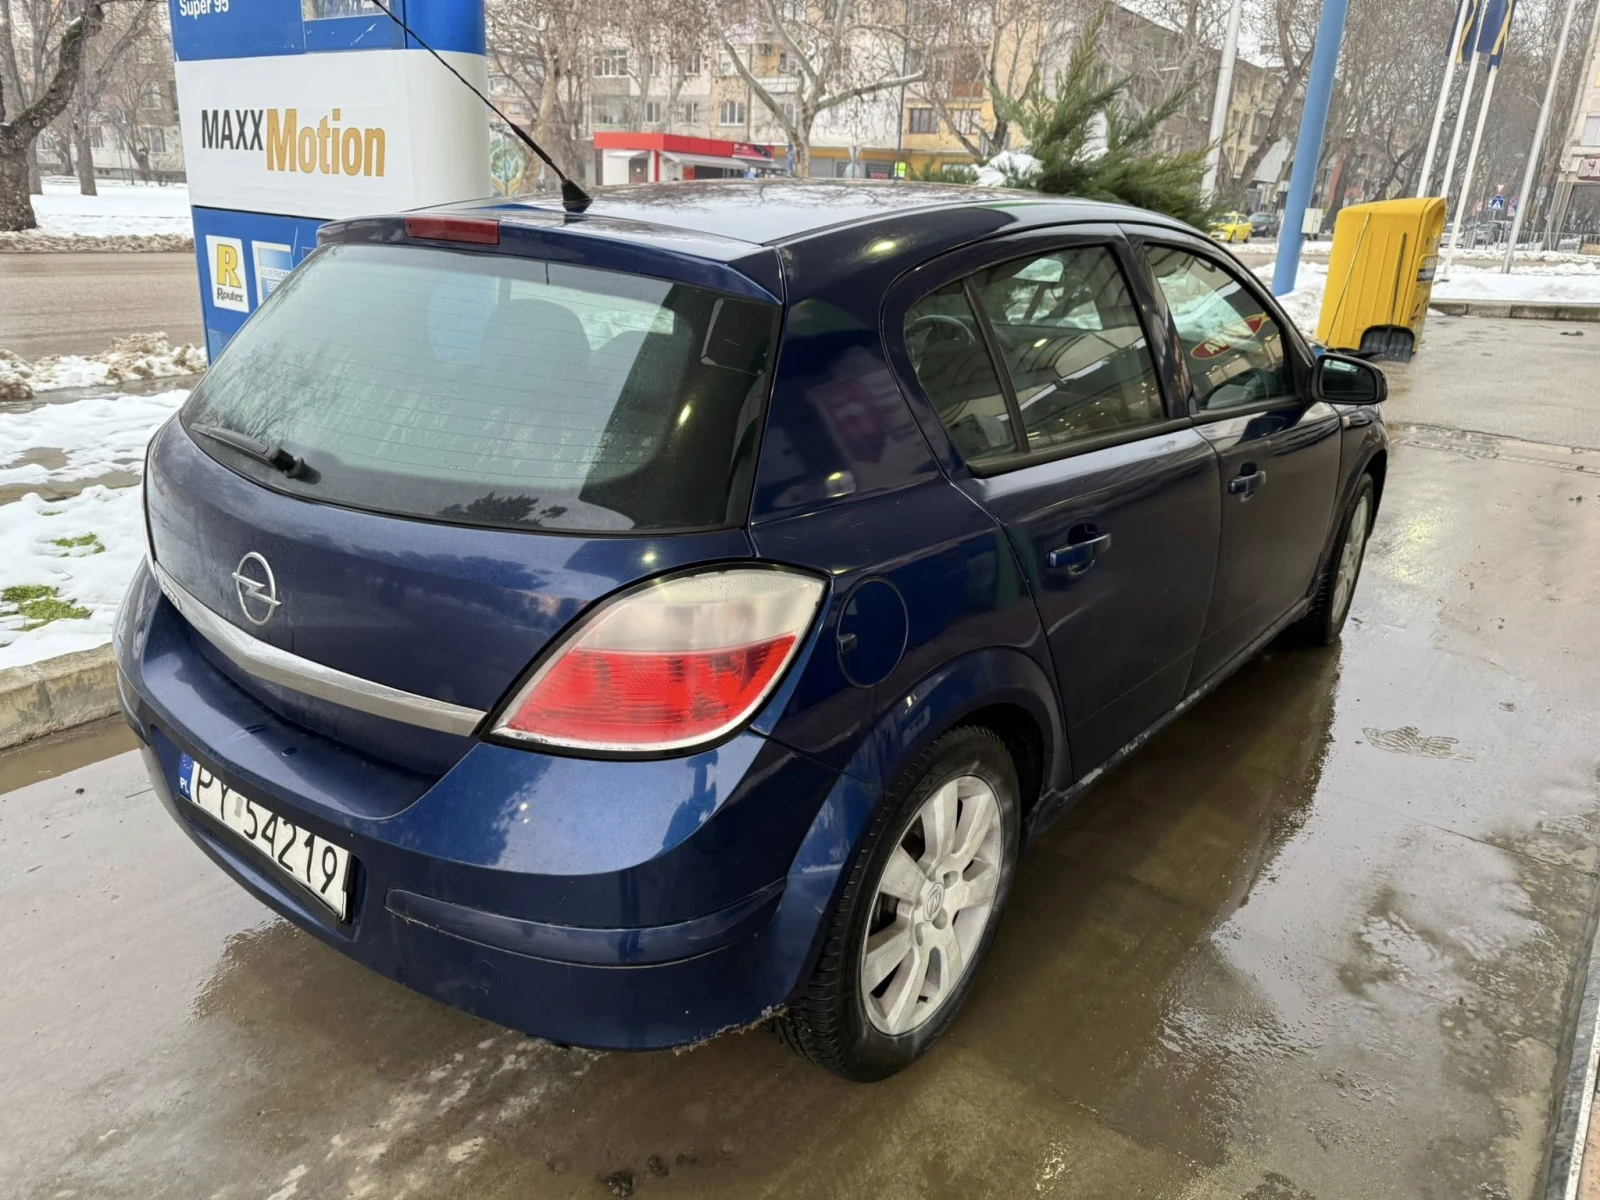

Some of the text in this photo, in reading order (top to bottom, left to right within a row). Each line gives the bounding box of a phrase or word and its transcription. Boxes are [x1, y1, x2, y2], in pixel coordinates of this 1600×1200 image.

[179, 0, 230, 20] Super 95
[217, 287, 244, 303] Routex
[179, 776, 190, 794] PL
[243, 798, 338, 895] 54219
